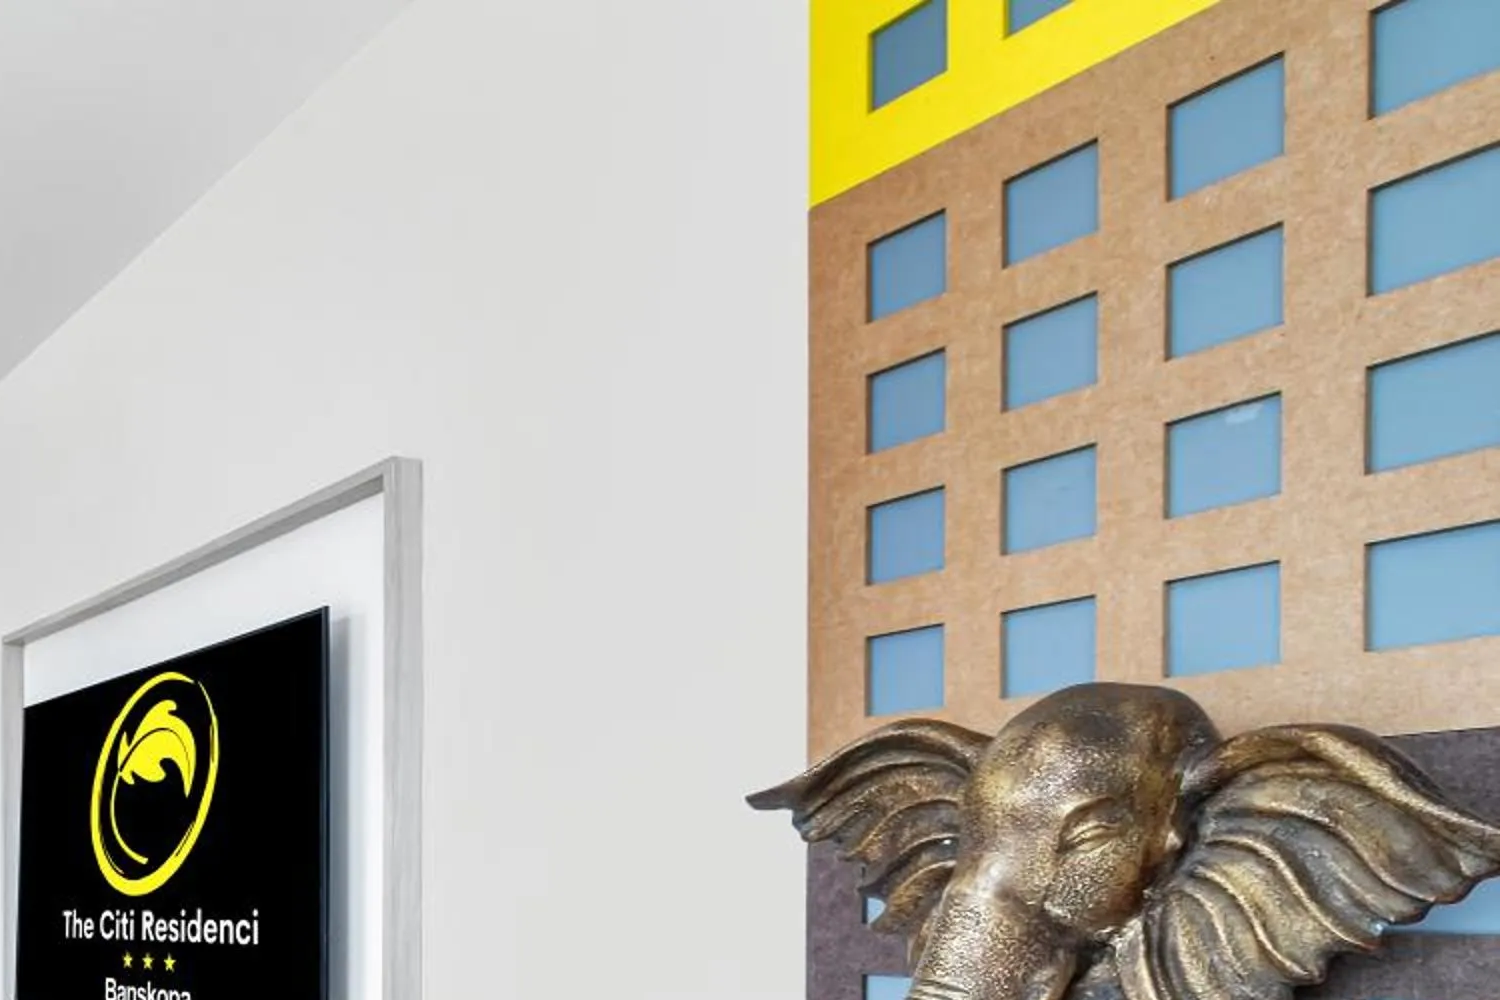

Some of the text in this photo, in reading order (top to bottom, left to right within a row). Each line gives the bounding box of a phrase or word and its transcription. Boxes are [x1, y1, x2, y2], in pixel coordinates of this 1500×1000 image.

[63, 908, 259, 945] The Citi Residenci
